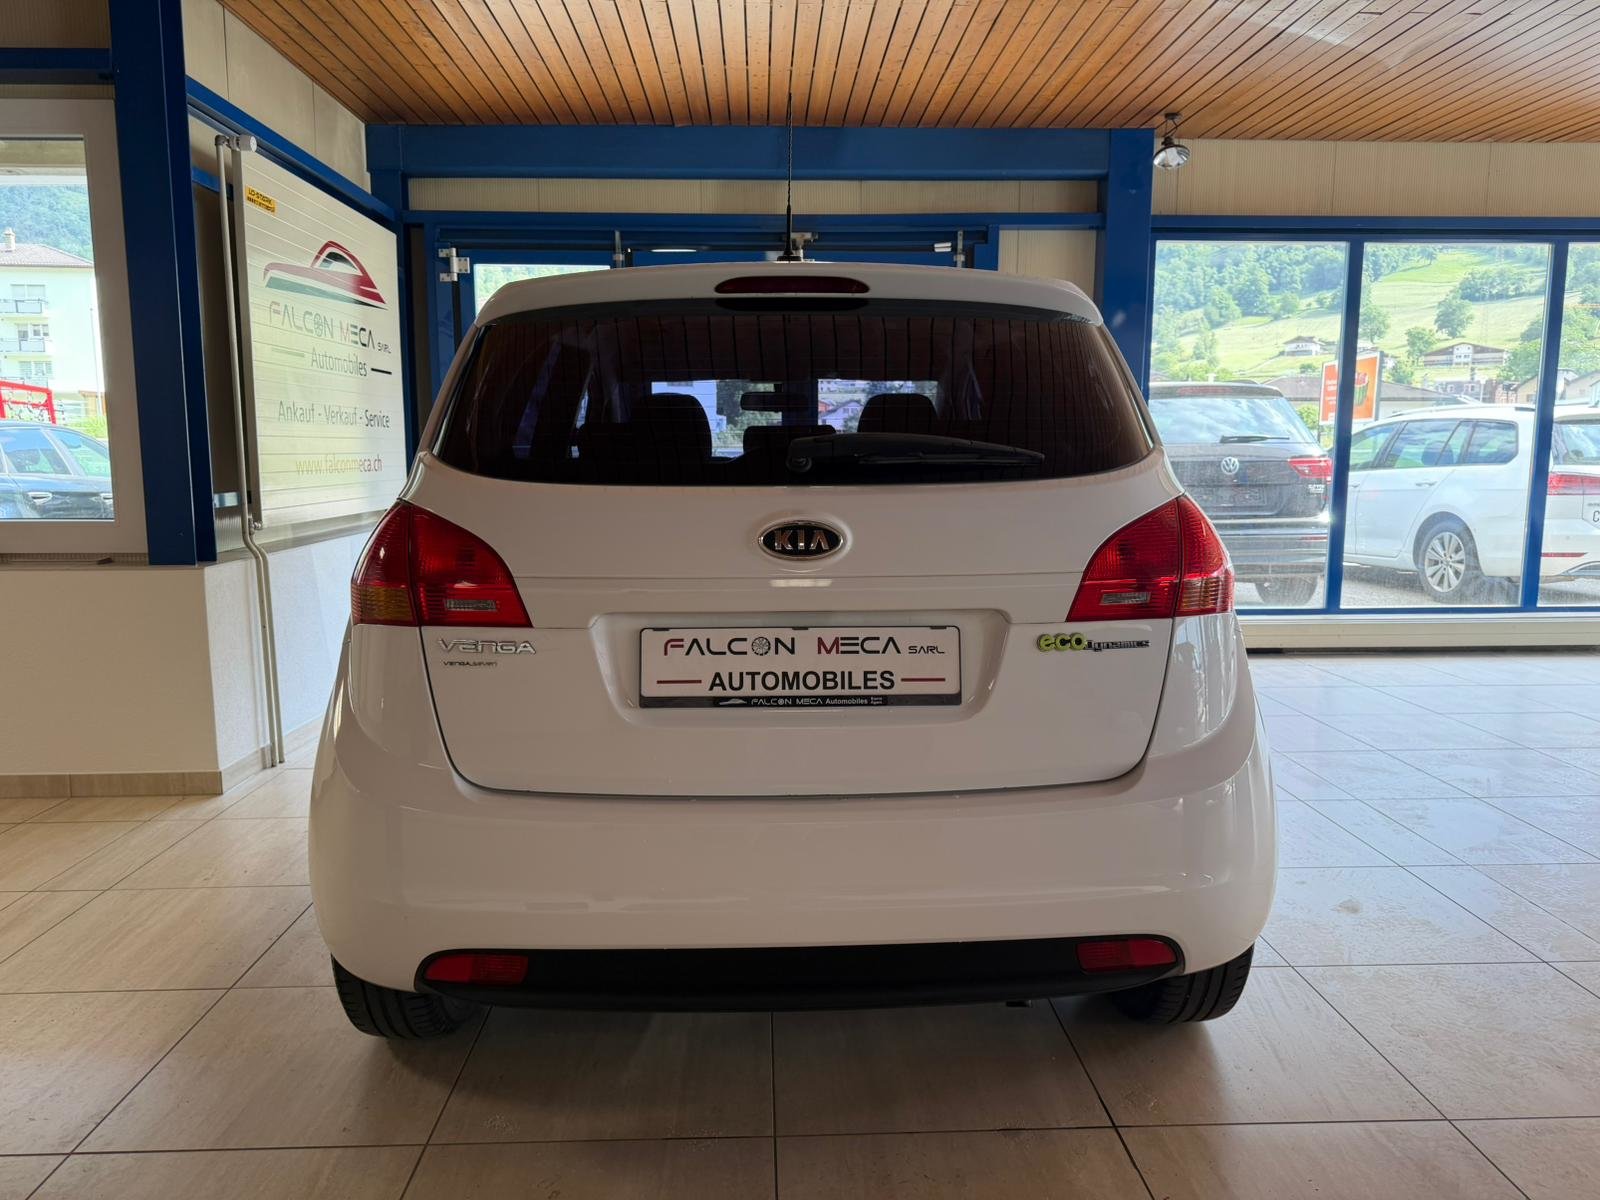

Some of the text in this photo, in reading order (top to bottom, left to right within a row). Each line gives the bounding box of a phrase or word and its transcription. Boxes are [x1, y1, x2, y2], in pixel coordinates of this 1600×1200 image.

[269, 300, 334, 339] FALCON
[339, 319, 376, 350] MECA
[311, 347, 368, 377] Automobiles
[278, 400, 316, 423] Ankauf
[323, 404, 358, 426] Verkauf
[364, 409, 390, 428] Service
[295, 453, 383, 476] www.falconmeca.ch
[773, 529, 830, 550] KIA
[664, 636, 945, 656] FALCON MECA SARL
[708, 670, 896, 692] AUTOMOBILES
[751, 698, 793, 706] FALCON
[796, 697, 823, 705] MECA
[825, 696, 869, 705] Automobiles
